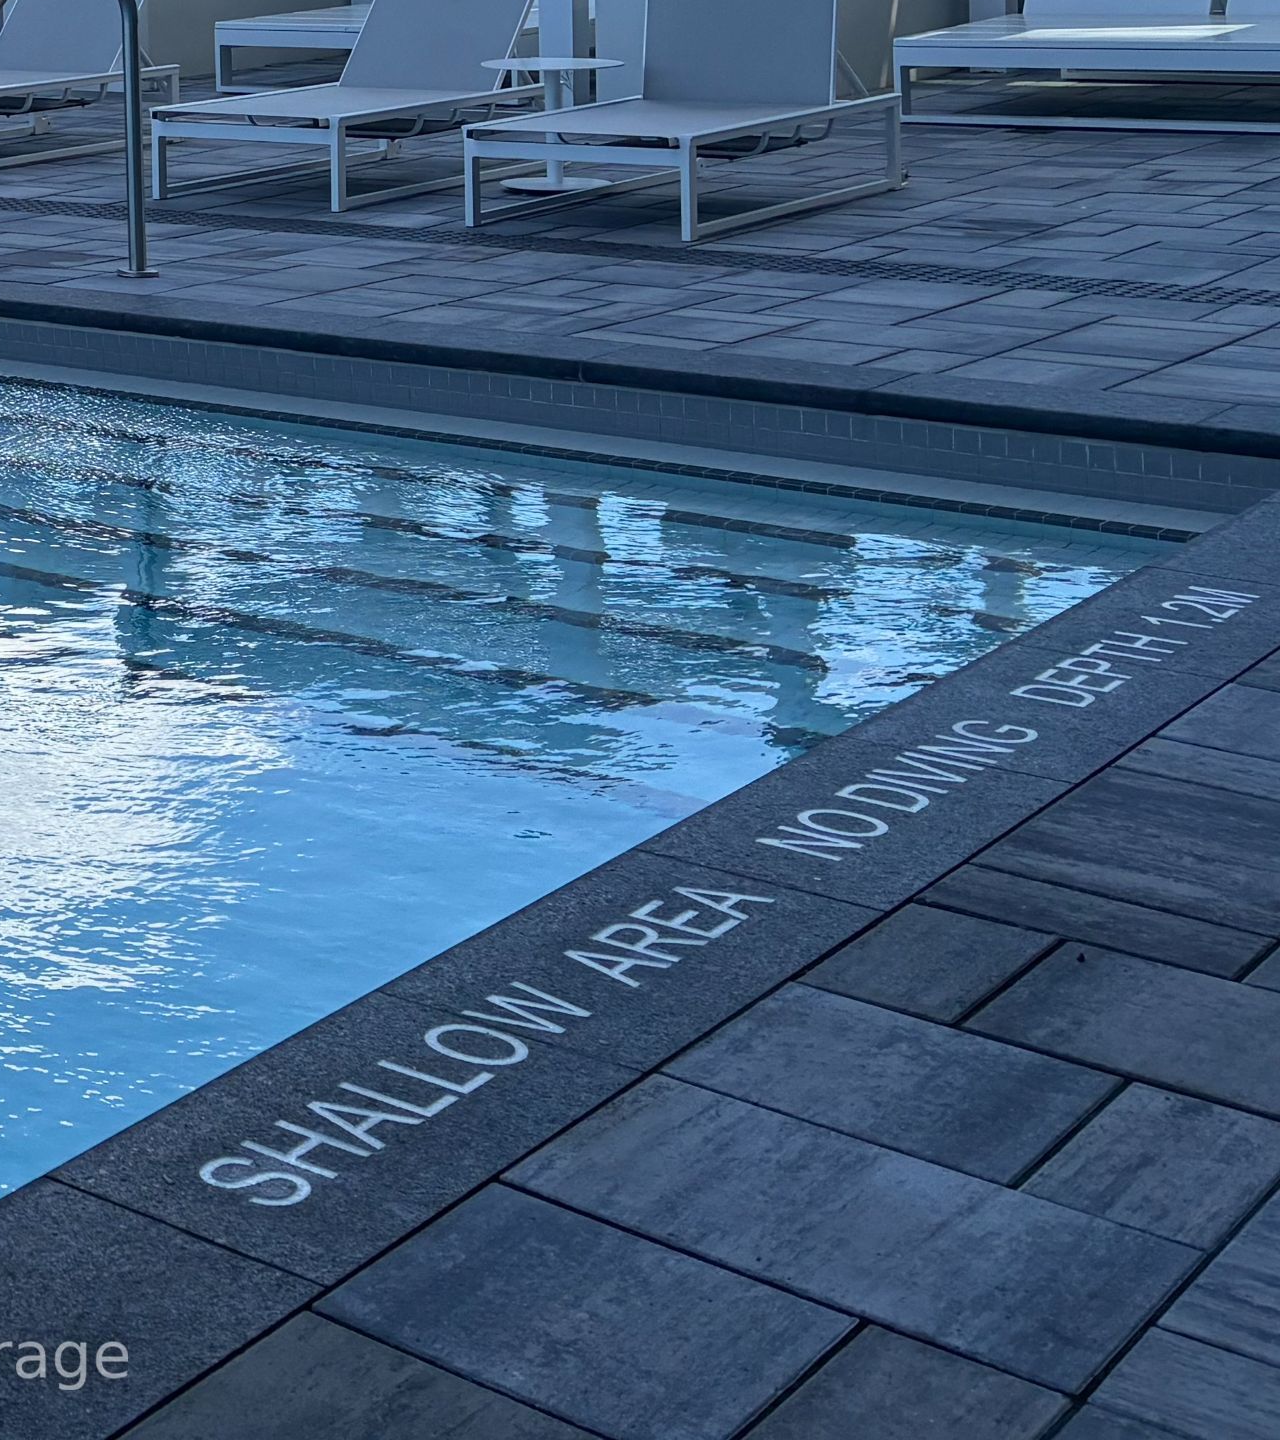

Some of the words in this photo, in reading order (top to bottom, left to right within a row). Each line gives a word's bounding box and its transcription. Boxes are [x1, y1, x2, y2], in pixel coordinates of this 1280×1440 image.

[198, 980, 593, 1207] SHALLOW
[563, 885, 775, 988] AREA
[754, 809, 889, 862] NO
[833, 719, 1039, 815] DIVING
[1008, 630, 1189, 708] DEPTH
[1139, 585, 1261, 629] 1.2M
